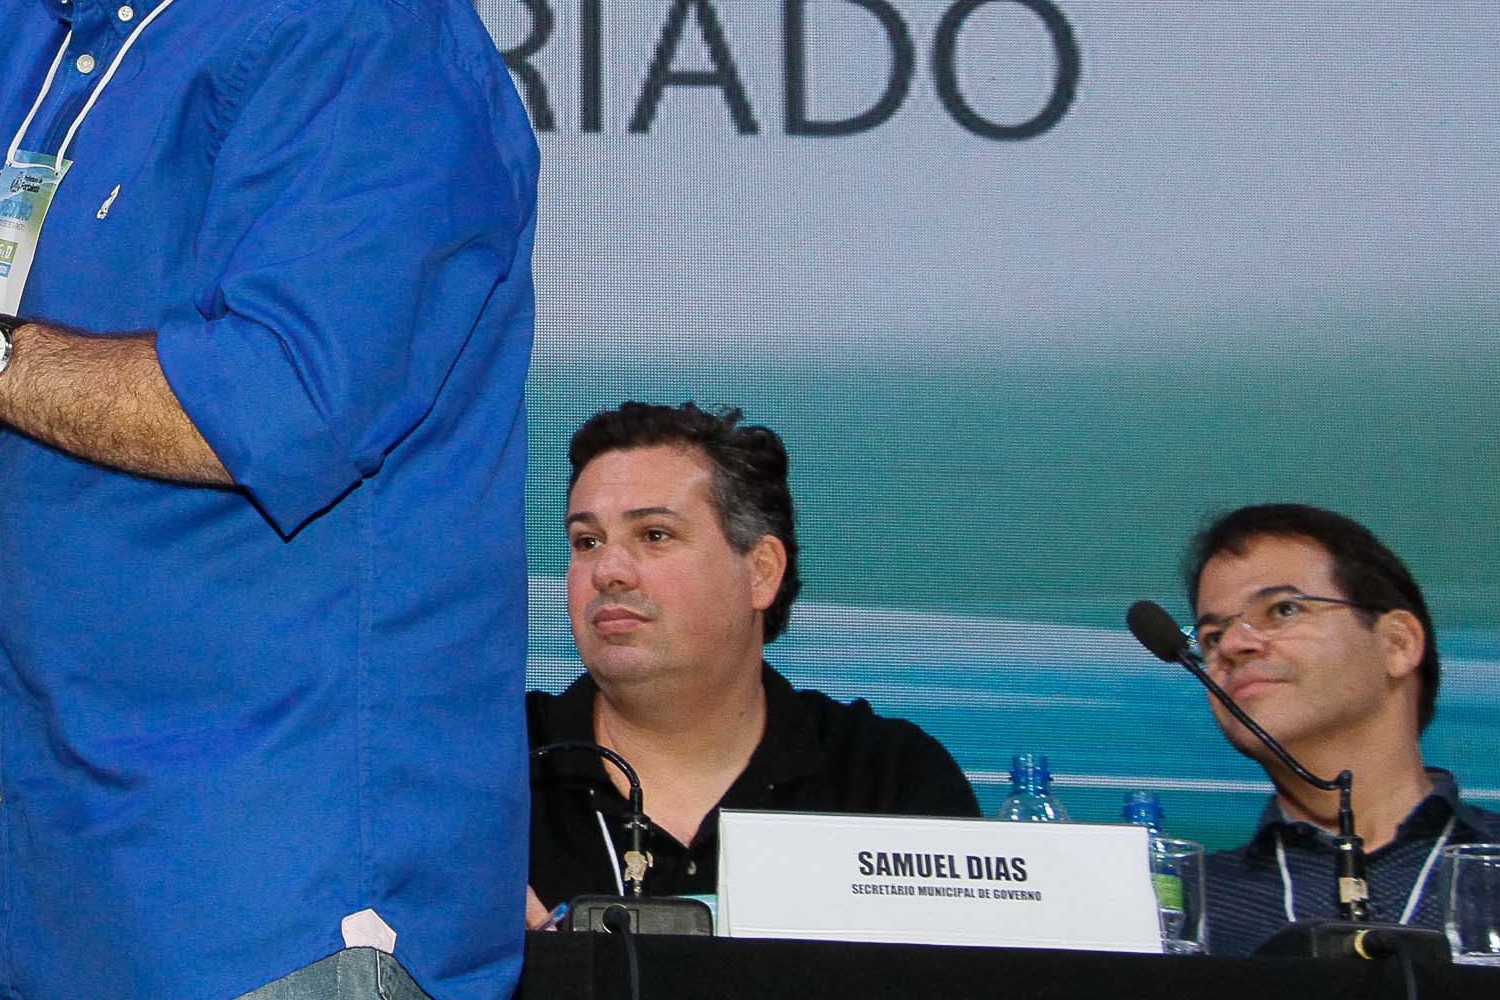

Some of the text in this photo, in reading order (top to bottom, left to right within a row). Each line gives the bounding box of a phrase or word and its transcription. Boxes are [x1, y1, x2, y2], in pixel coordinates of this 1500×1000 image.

[857, 850, 1028, 882] SAMUEL DIAS
[918, 886, 976, 898] MUNICIPAL
[978, 888, 990, 899] DE
[993, 889, 1042, 901] GOVERNO
